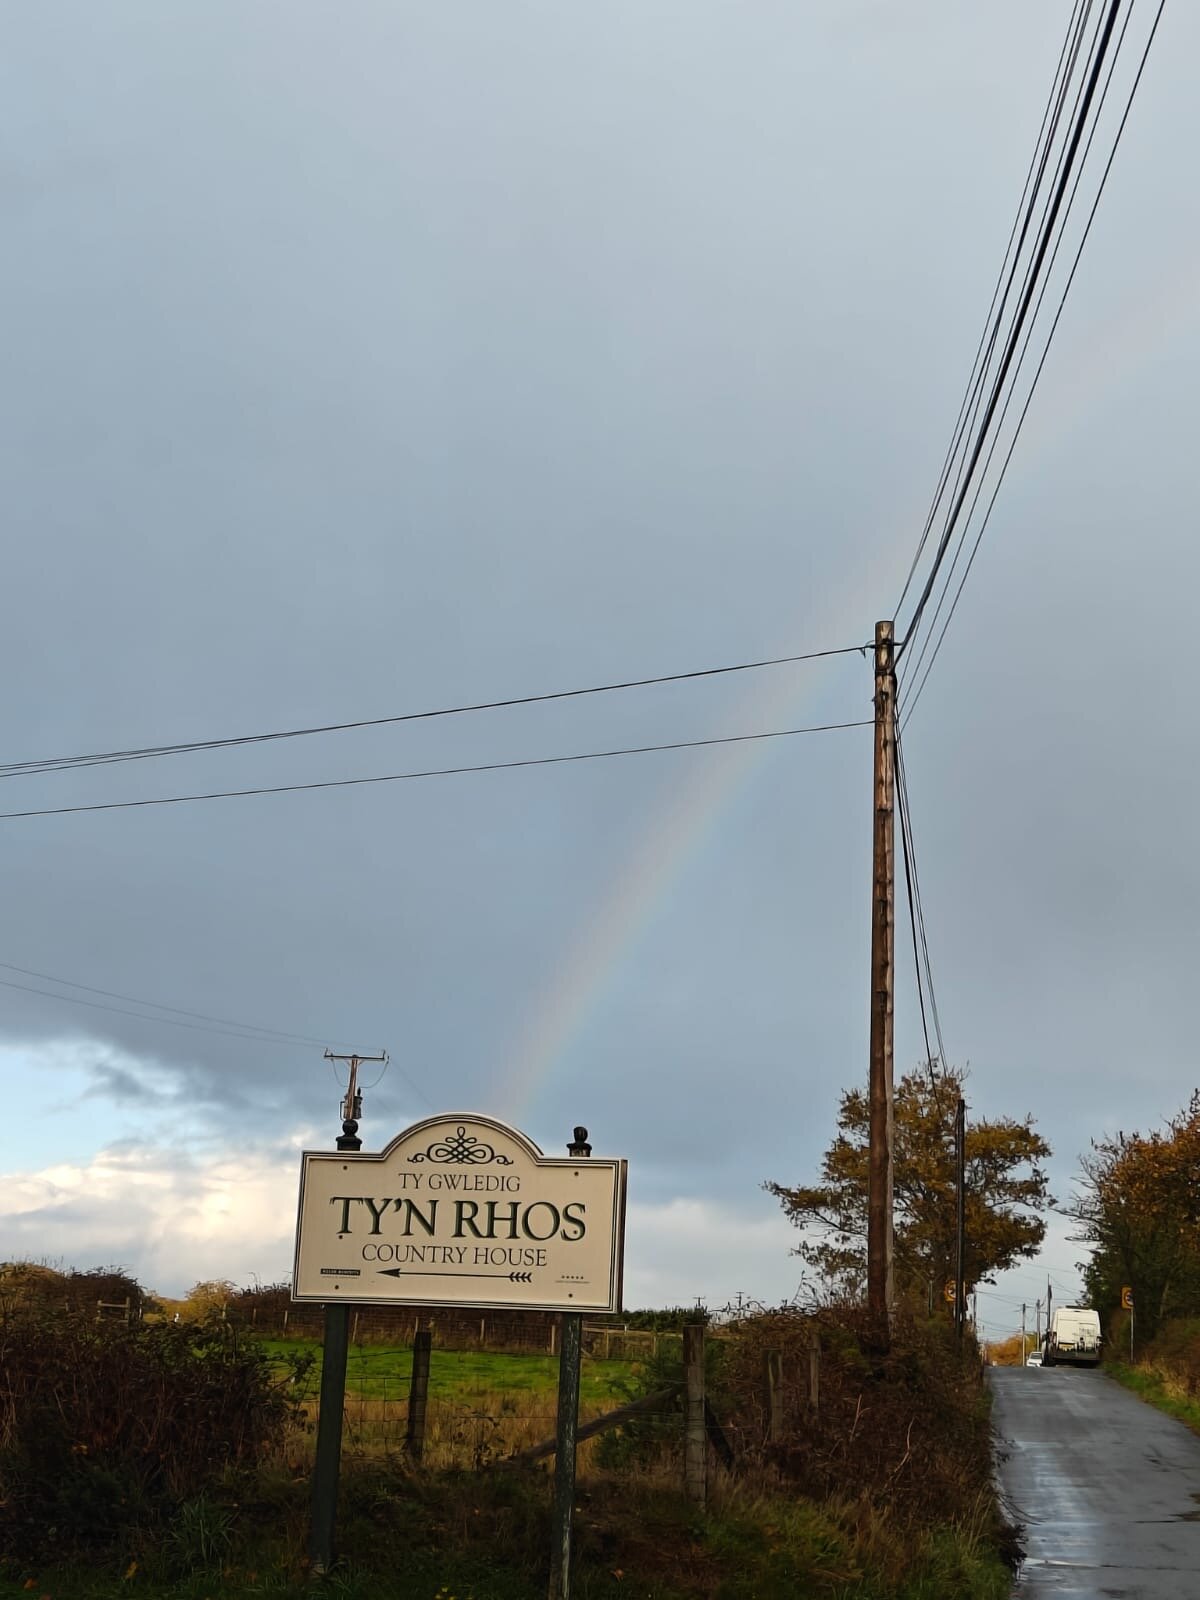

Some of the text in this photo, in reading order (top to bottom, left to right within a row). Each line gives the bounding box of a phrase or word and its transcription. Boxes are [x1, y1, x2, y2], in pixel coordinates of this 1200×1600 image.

[398, 1173, 520, 1192] TY GWLEDIG
[330, 1196, 586, 1241] TY'N RHOS
[362, 1244, 547, 1266] COUNTRY HOUSE
